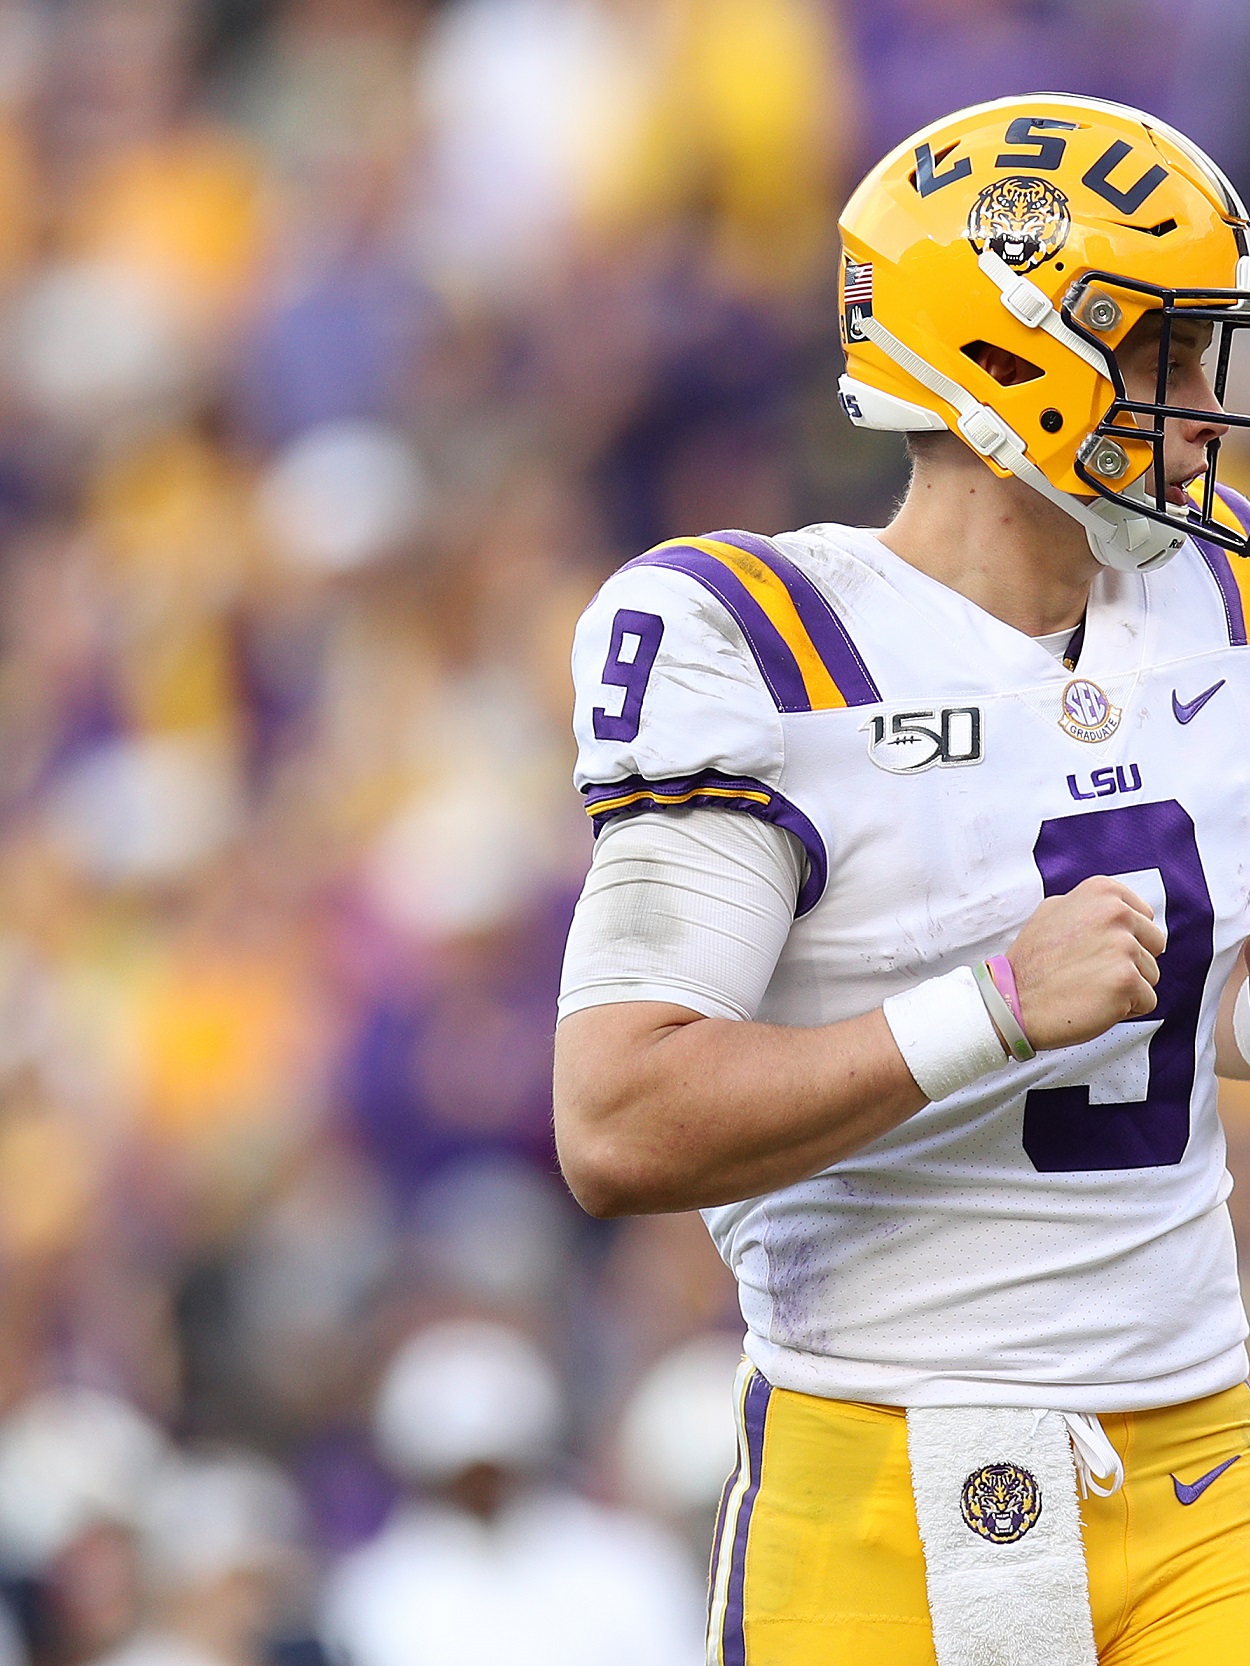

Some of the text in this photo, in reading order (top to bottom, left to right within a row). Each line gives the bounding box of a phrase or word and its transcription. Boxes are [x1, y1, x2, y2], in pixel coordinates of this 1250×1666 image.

[915, 117, 1169, 215] LSU
[592, 608, 665, 743] 9
[1065, 682, 1107, 726] SEC
[871, 706, 981, 770] 150
[1070, 718, 1117, 741] GRADUATE
[1066, 763, 1143, 801] LSU
[1022, 798, 1215, 1173] 9
